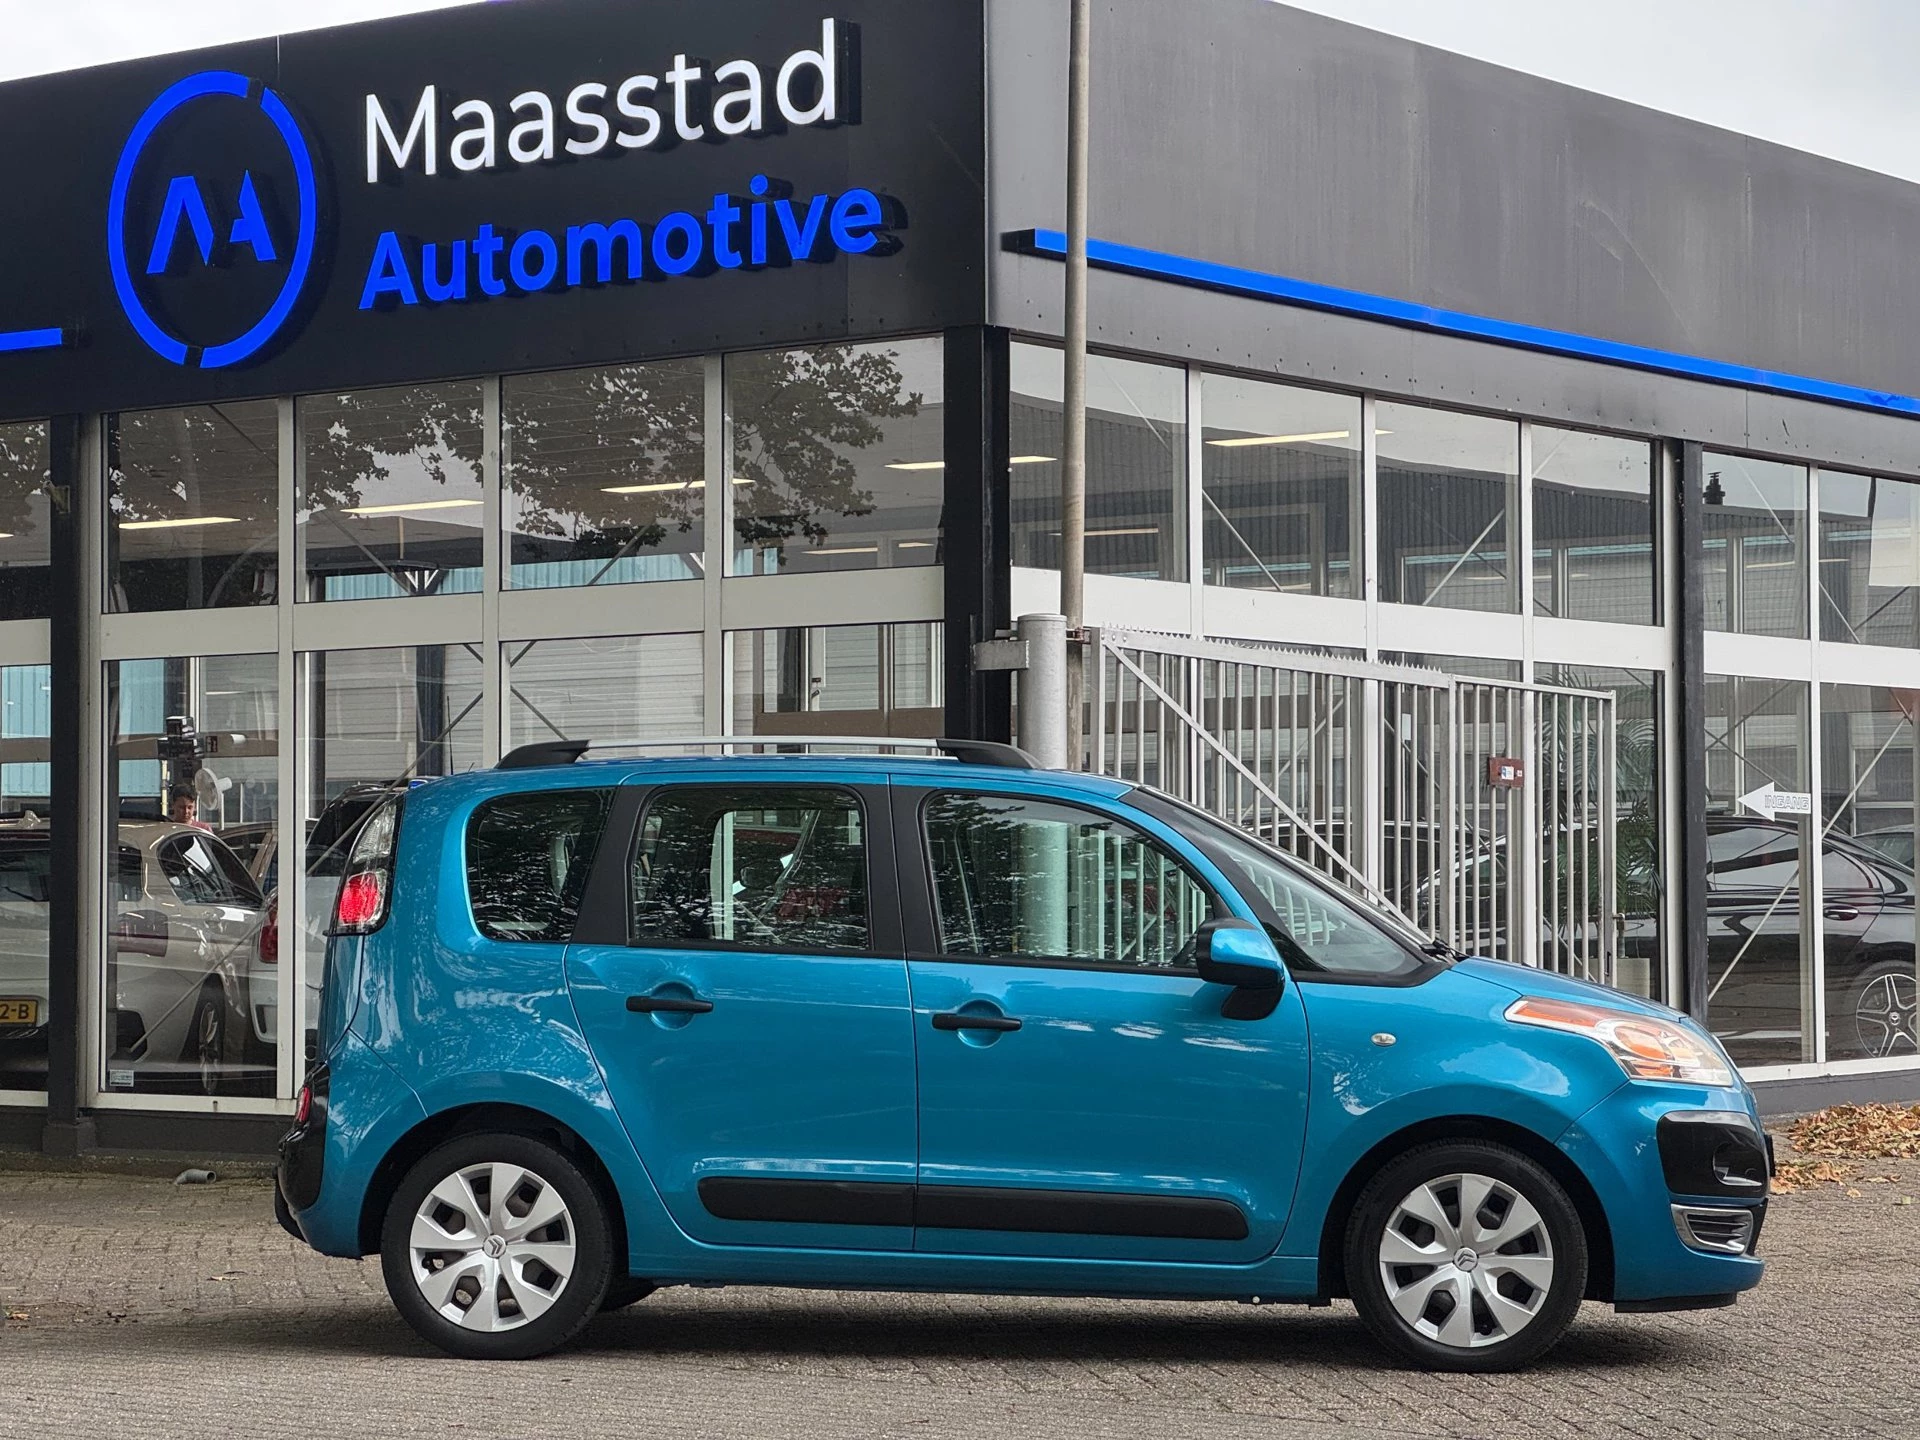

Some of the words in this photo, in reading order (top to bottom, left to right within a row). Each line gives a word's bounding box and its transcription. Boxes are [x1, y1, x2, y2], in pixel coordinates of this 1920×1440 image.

[365, 18, 836, 183] Maasstad
[359, 175, 883, 310] Automotive
[1764, 794, 1809, 810] INGANG
